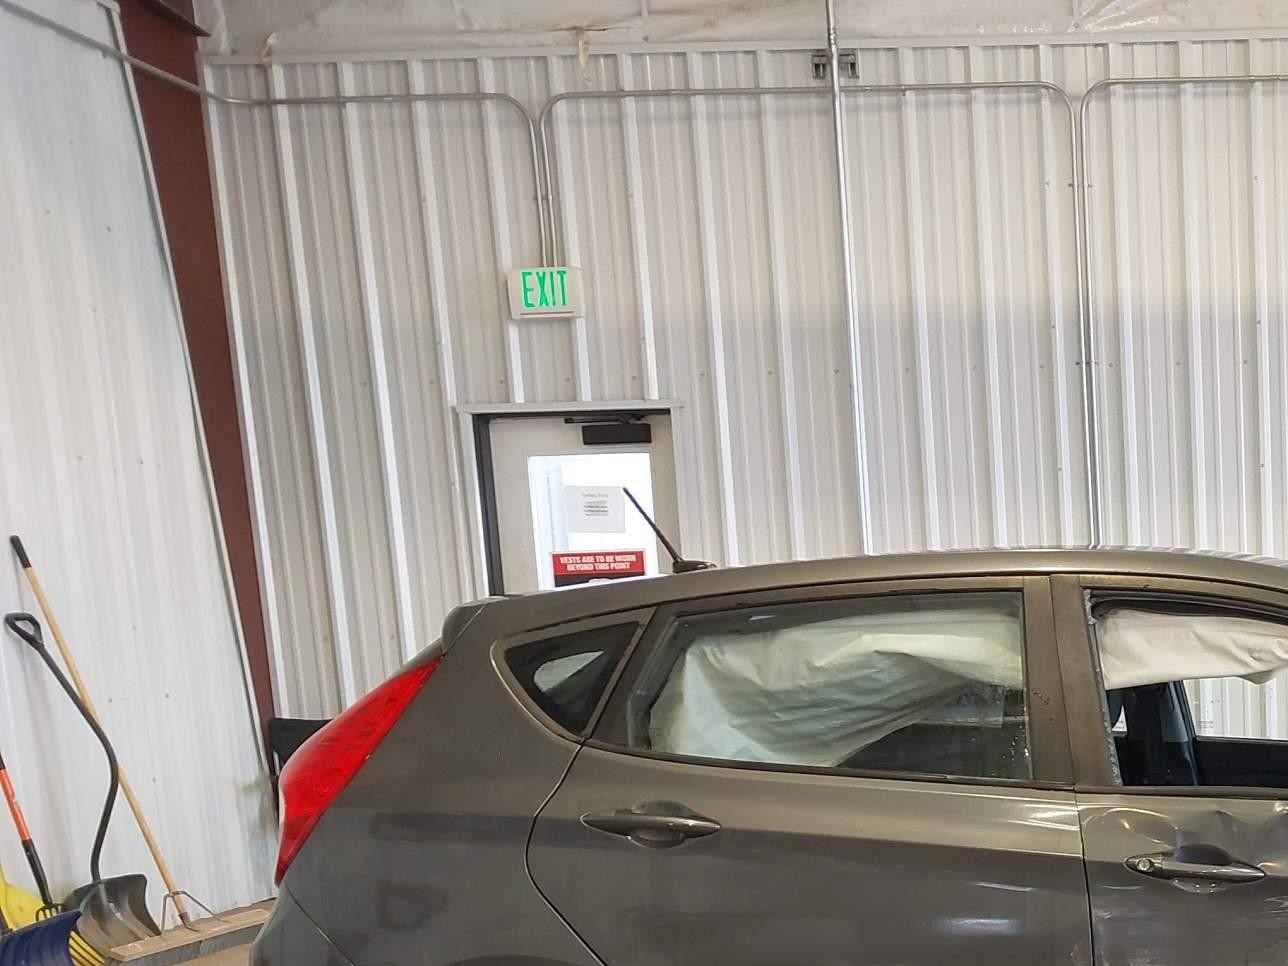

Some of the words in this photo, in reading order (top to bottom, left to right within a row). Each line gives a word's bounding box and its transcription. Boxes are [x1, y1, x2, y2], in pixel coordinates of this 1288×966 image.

[521, 270, 567, 308] EXIT
[560, 556, 581, 564] VESTS
[595, 555, 605, 563] TO
[615, 554, 637, 562] WORN
[567, 563, 594, 571] BEYOND
